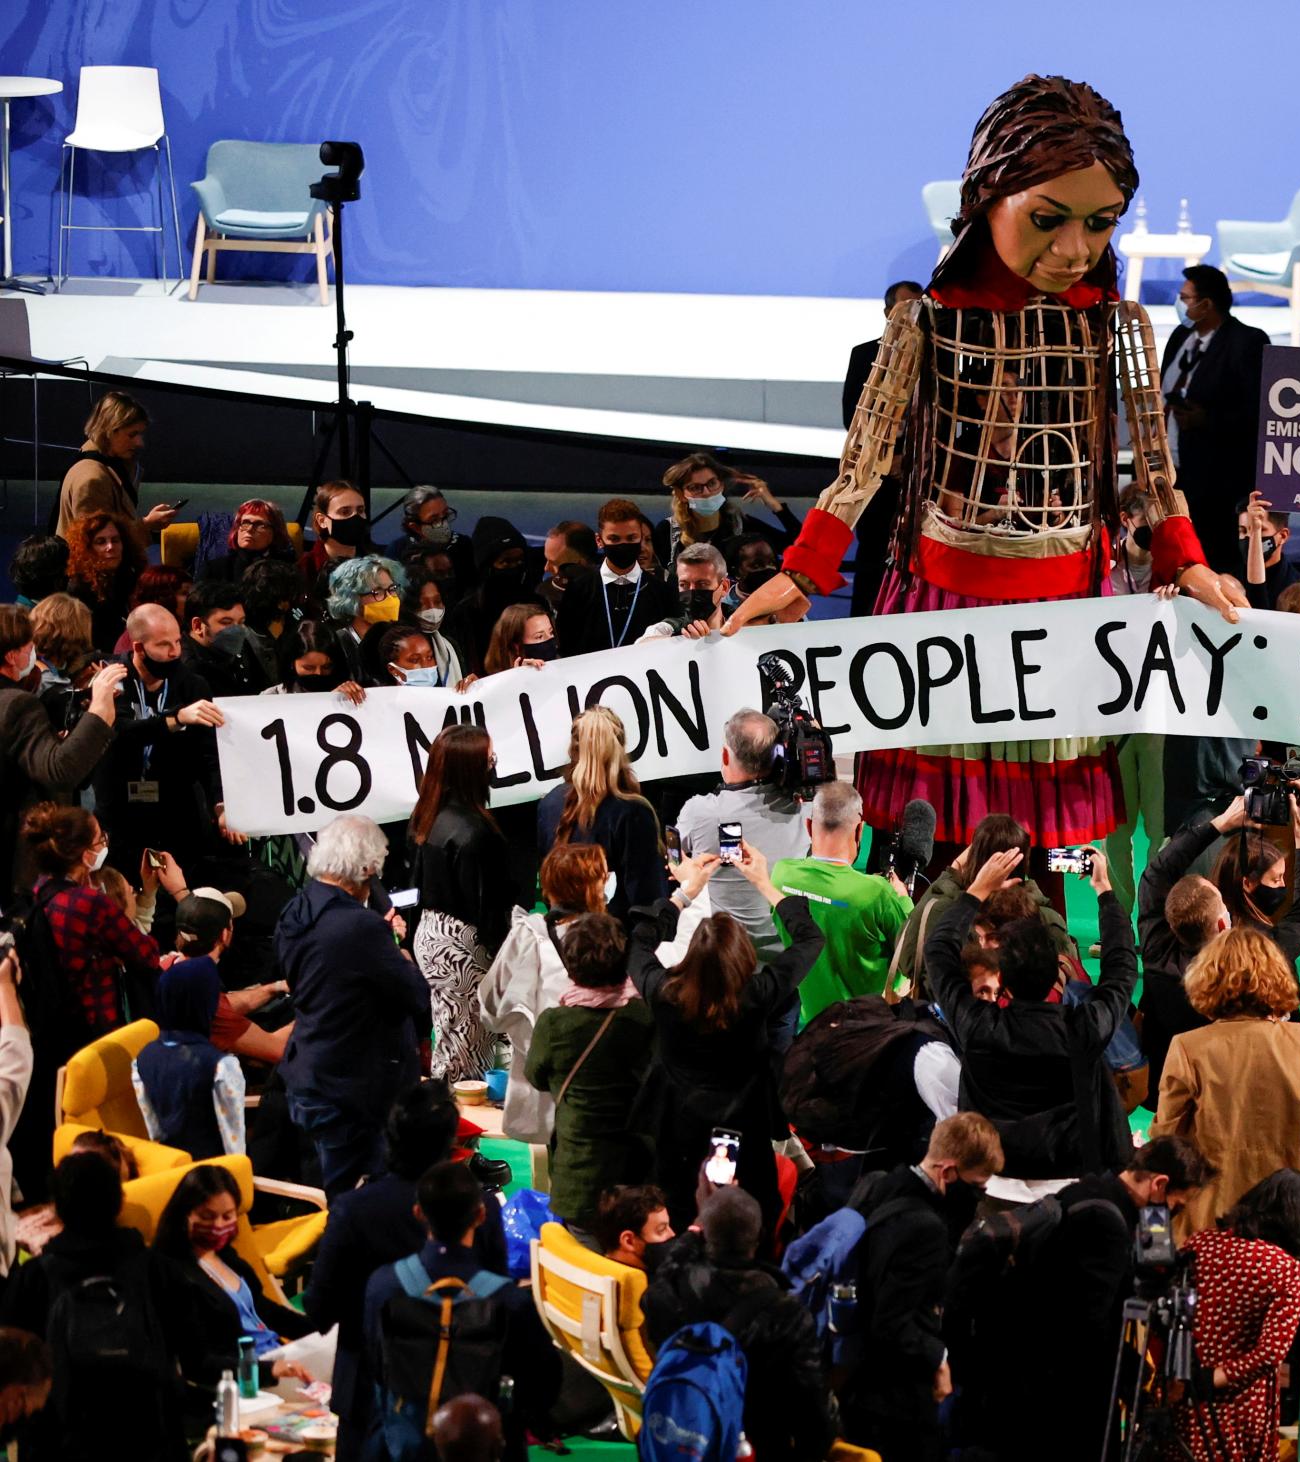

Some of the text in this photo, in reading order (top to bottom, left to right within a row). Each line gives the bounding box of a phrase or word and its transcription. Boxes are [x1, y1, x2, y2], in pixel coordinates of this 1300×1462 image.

[261, 713, 372, 816] 1.8
[403, 660, 710, 796] MLLON
[757, 628, 1056, 736] PEOPLE
[1095, 620, 1268, 721] SAY:
